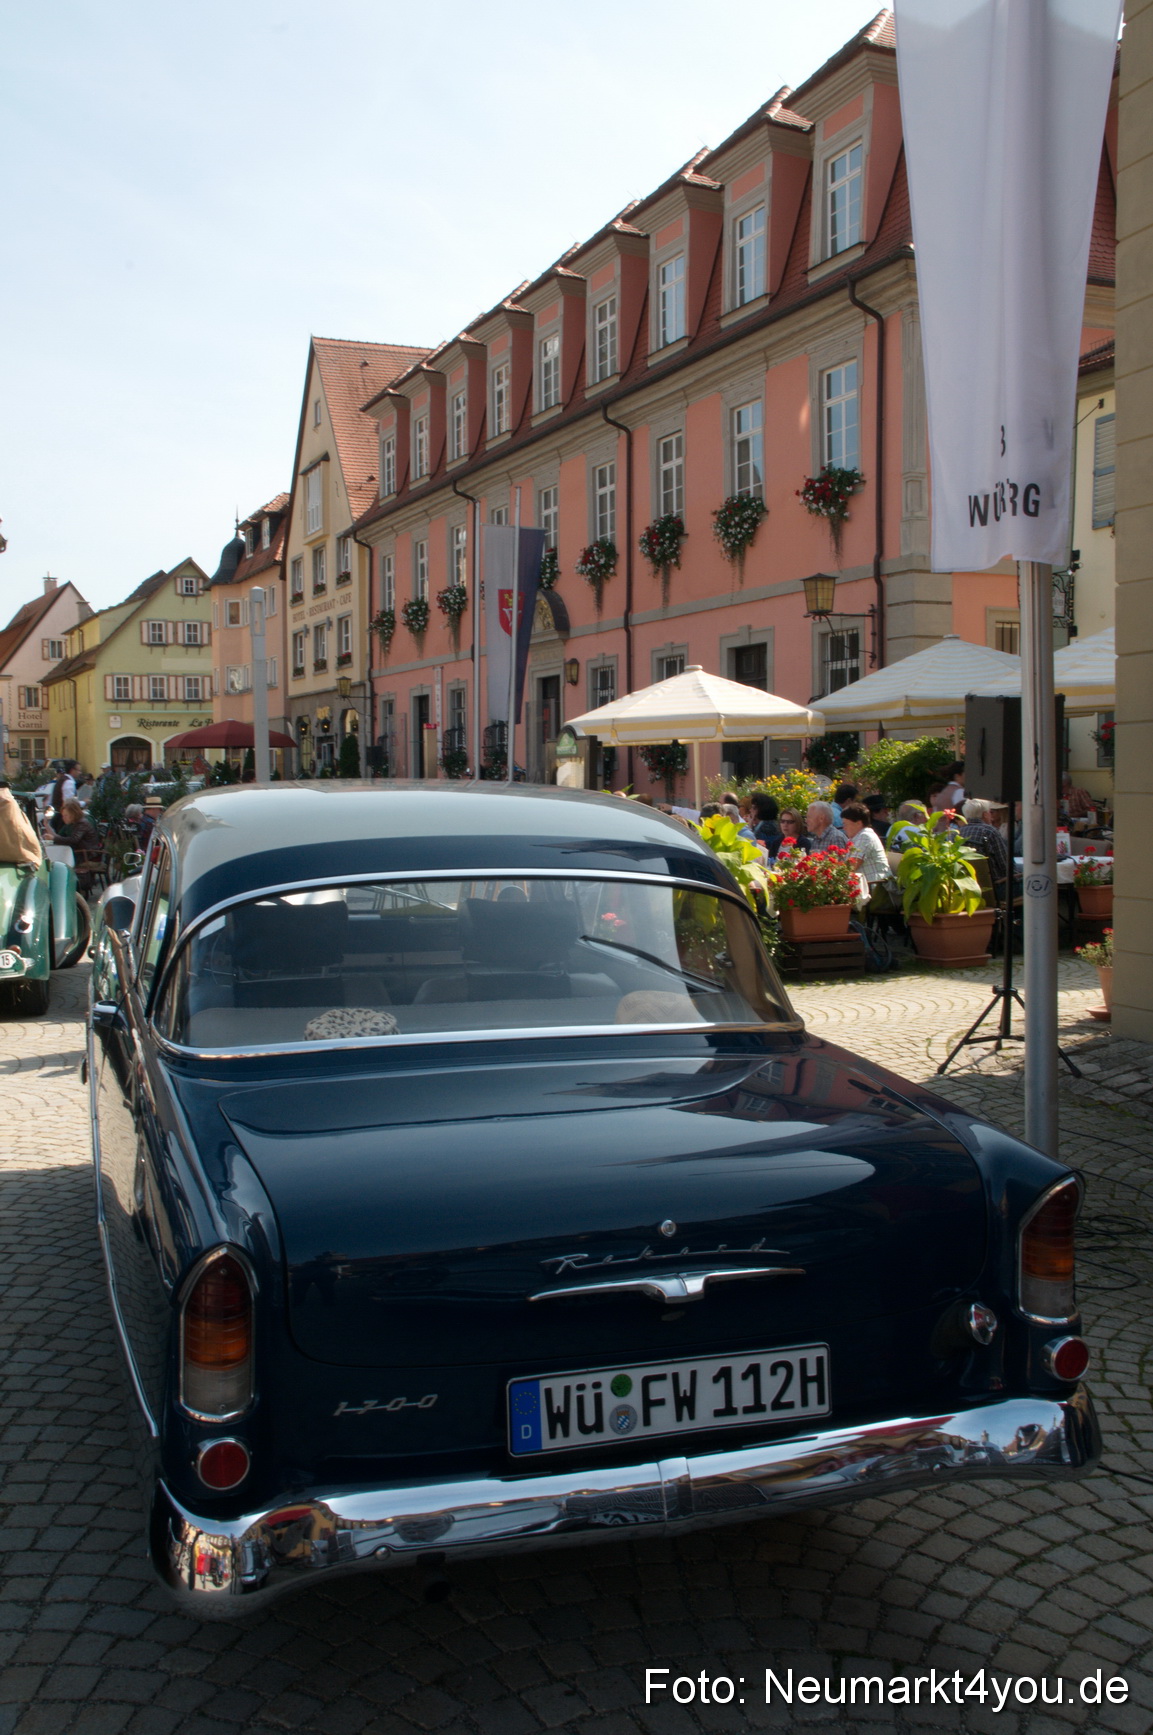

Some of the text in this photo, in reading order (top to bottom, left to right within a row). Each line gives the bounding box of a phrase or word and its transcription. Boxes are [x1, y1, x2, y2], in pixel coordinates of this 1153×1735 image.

[17, 711, 43, 720] Hotel
[17, 720, 43, 729] Garni
[137, 717, 180, 730] Ristorante
[641, 1370, 698, 1427] FW
[712, 1355, 827, 1418] 112H
[333, 1394, 438, 1416] 1700
[521, 1424, 532, 1440] D
